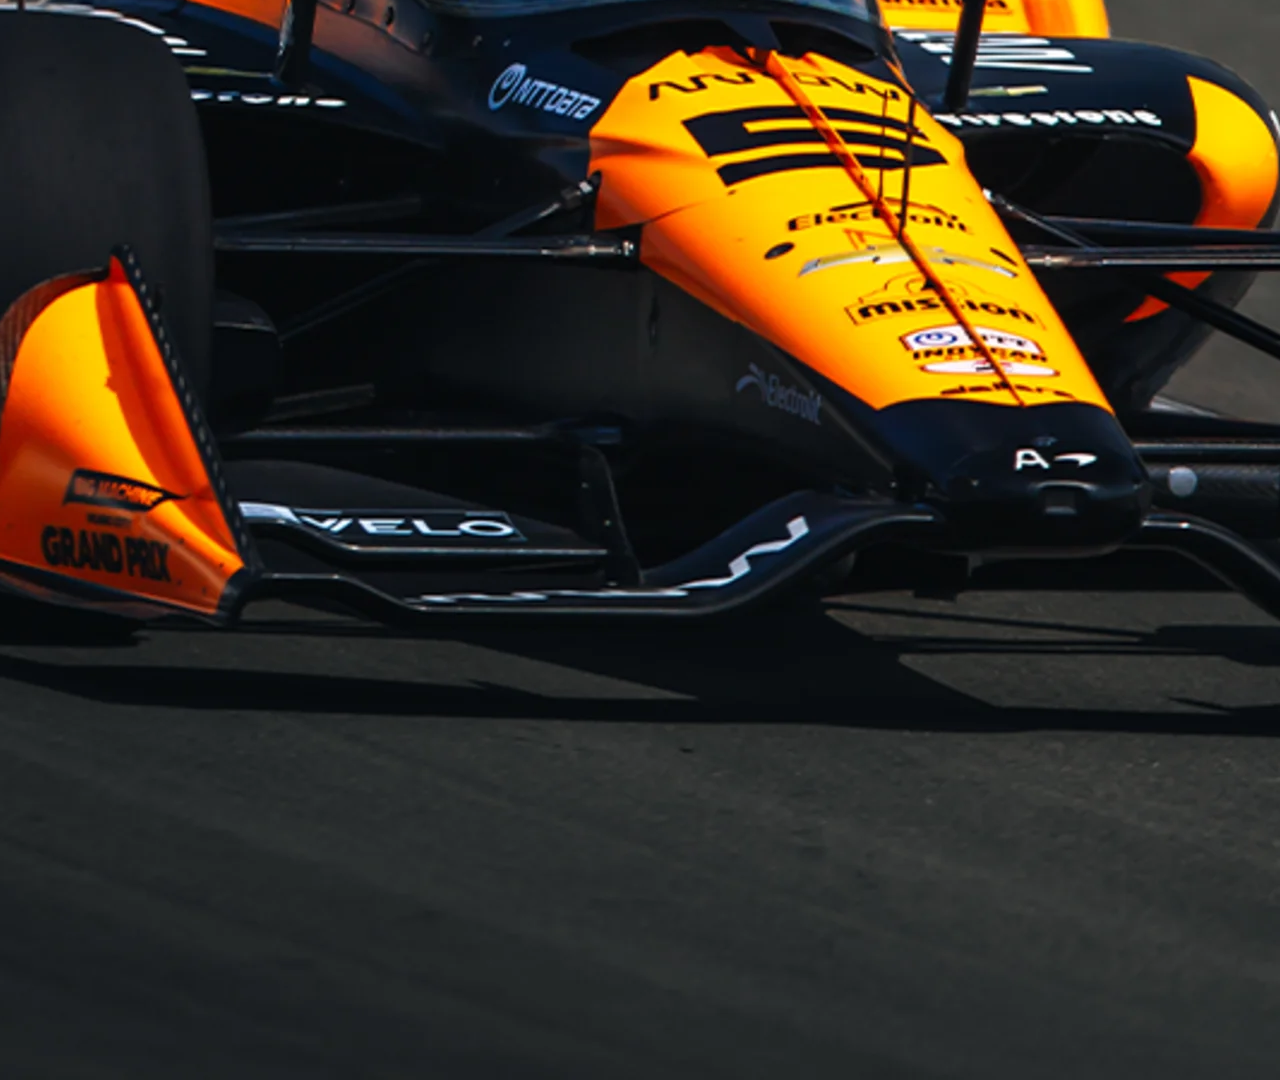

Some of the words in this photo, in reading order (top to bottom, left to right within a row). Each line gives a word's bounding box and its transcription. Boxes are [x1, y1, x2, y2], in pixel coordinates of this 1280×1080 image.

[299, 515, 517, 538] VELO
[41, 524, 123, 573] GRAND
[124, 536, 172, 583] PRIX
